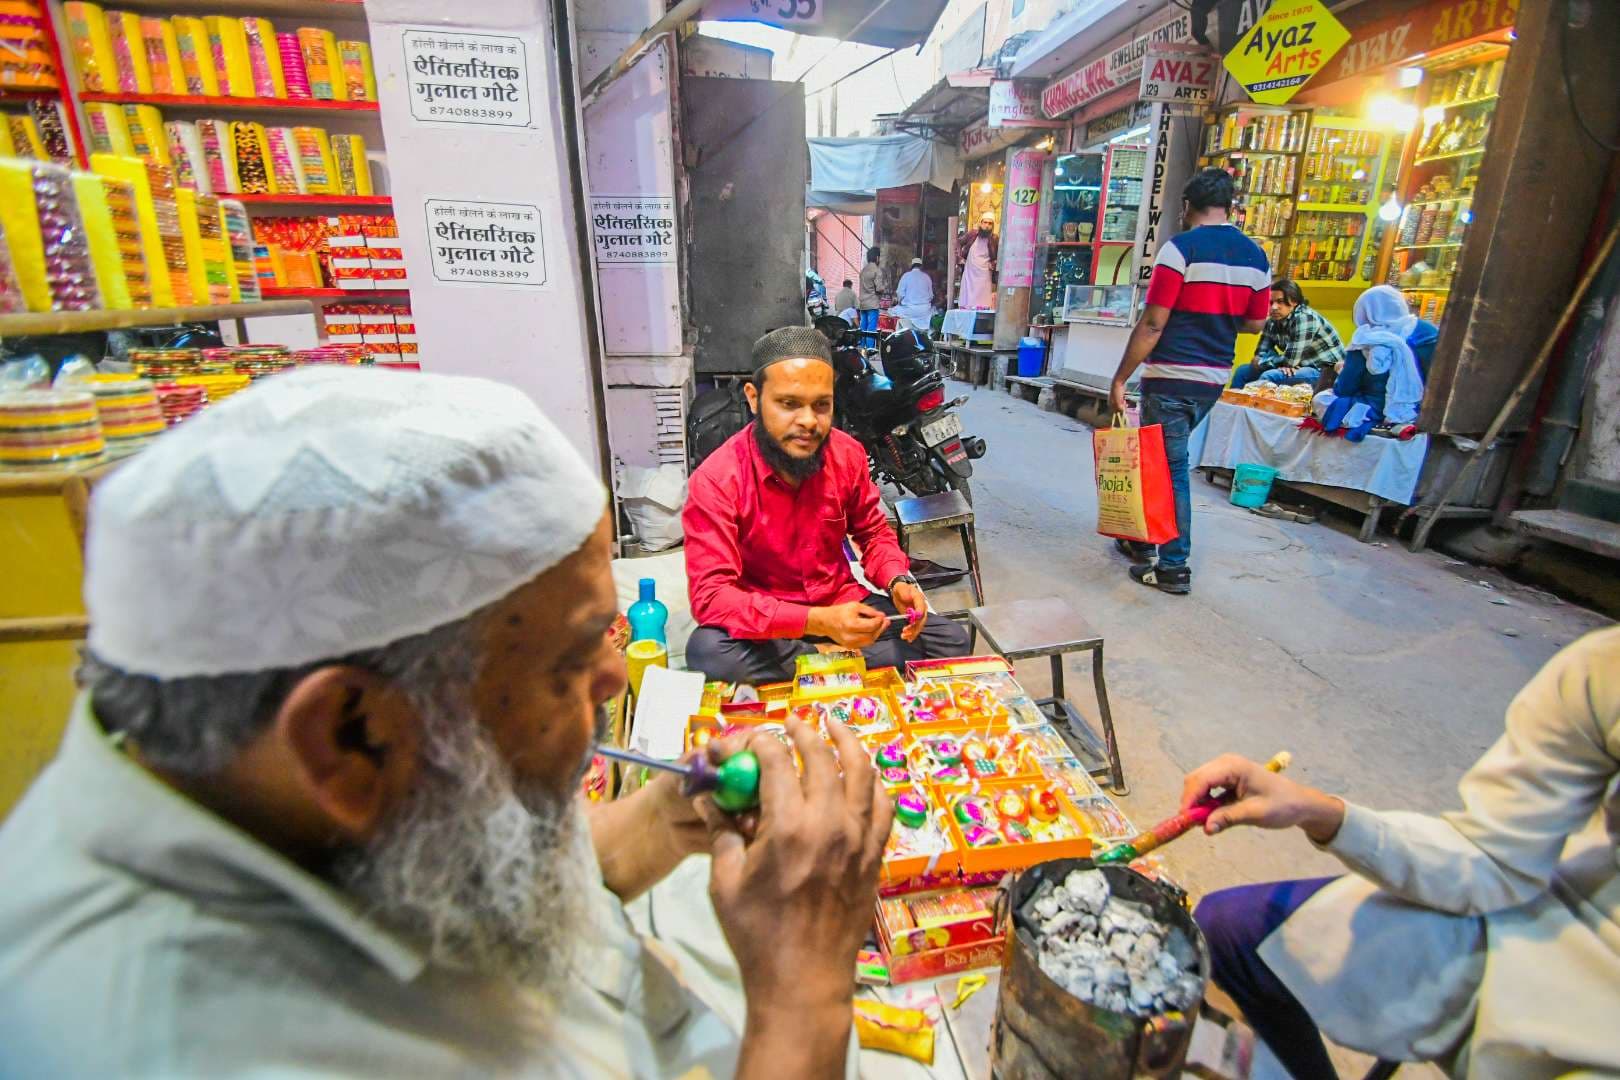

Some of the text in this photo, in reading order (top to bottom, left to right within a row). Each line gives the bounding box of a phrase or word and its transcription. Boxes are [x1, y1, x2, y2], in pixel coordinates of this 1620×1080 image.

[1268, 11, 1289, 21] Since
[1110, 36, 1150, 71] JEWELLERY
[1152, 15, 1188, 43] CENTRE
[1244, 21, 1317, 61] Ayaz
[1338, 22, 1412, 79] AYAZ
[412, 54, 519, 80] ऐतिहासिक
[1266, 47, 1322, 76] Arts
[1150, 59, 1211, 85] AYAZ
[416, 82, 519, 103] गुलाल गोटे
[1146, 83, 1208, 99] 129 ARTS
[429, 106, 513, 119] 8740883899
[1014, 189, 1036, 204] 127
[593, 213, 673, 230] ऐतिहासिक
[434, 221, 536, 244] ऐतिहासिक
[596, 231, 672, 249] गुलाल गोटे
[437, 246, 535, 264] गुलाल गोटे
[450, 268, 529, 278] 8740883899
[1138, 265, 1153, 280] 12
[1098, 475, 1132, 492] Pooja's
